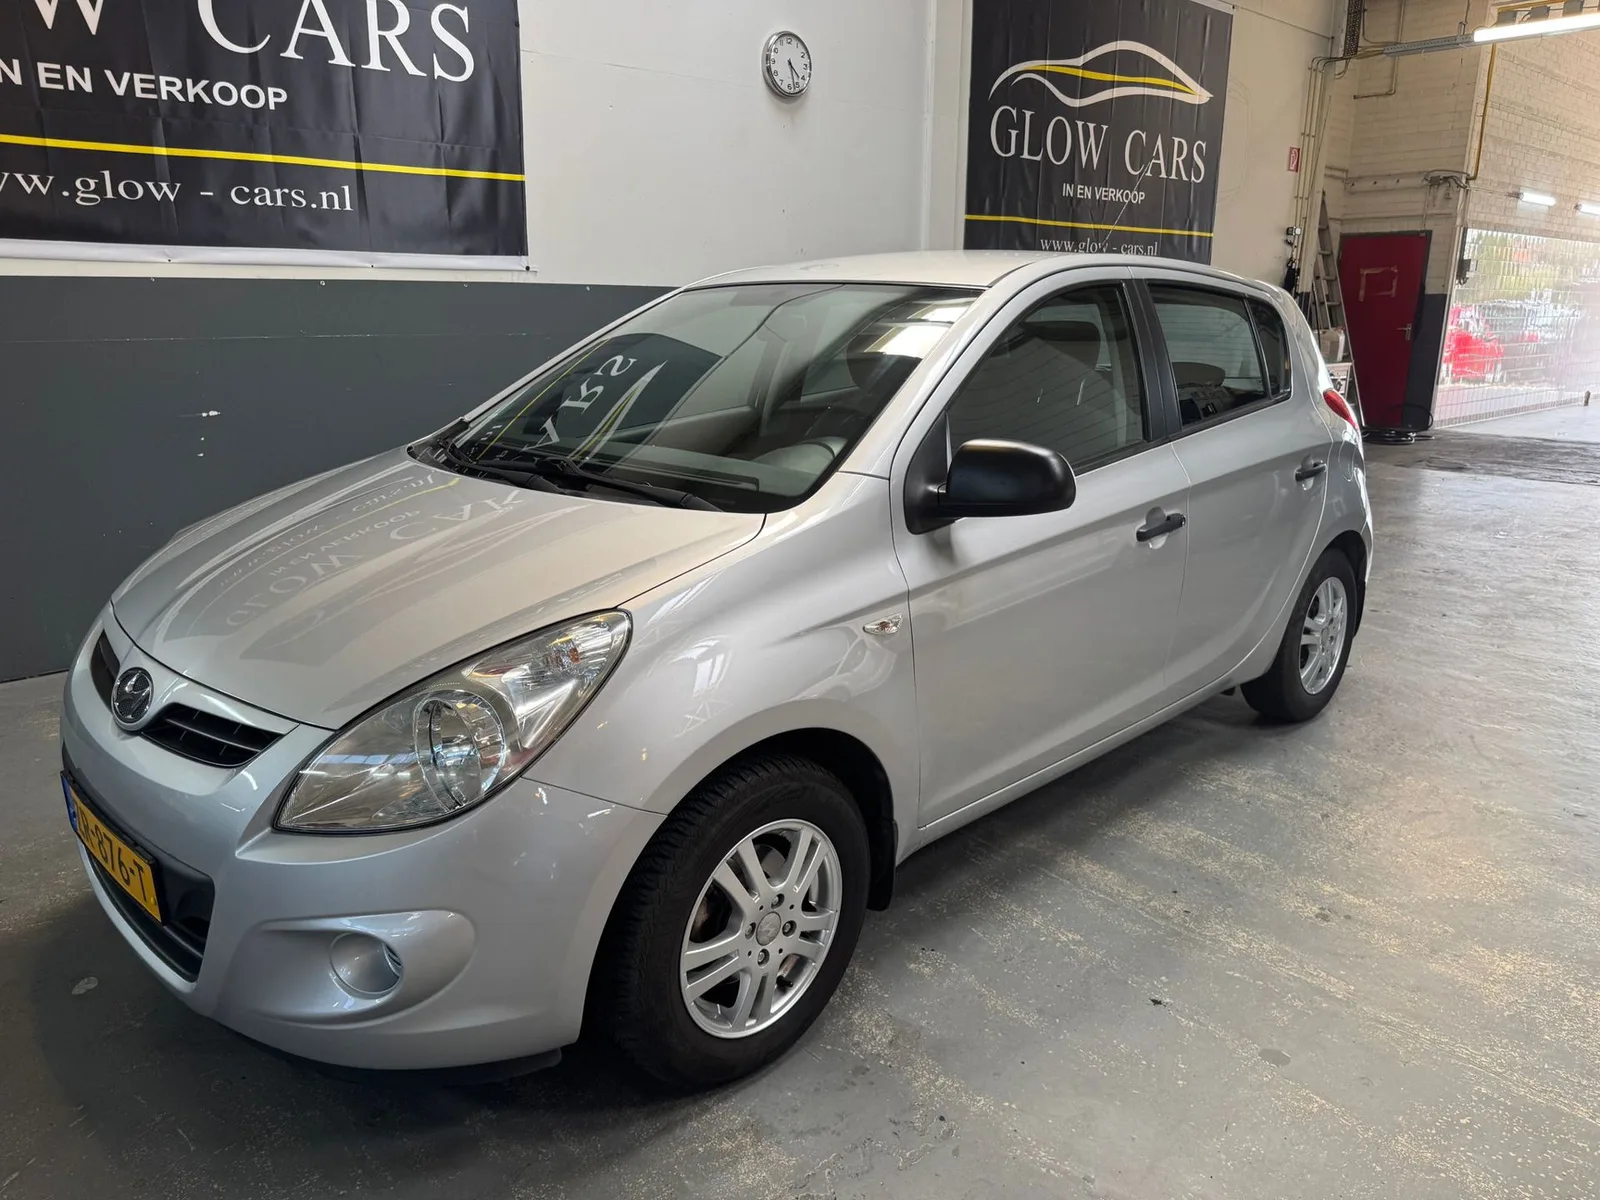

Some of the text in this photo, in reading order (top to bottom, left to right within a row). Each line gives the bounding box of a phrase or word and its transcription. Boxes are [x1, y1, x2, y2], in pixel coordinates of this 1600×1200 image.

[197, 0, 475, 83] CARS
[36, 61, 93, 93] EN
[104, 69, 288, 111] VERKOOP
[990, 105, 1207, 183] GLOW CARS
[0, 169, 182, 206] w.glow
[230, 184, 354, 212] cars.nl
[1062, 183, 1146, 204] IN EN VERKOOP
[1120, 242, 1158, 256] cars.nl
